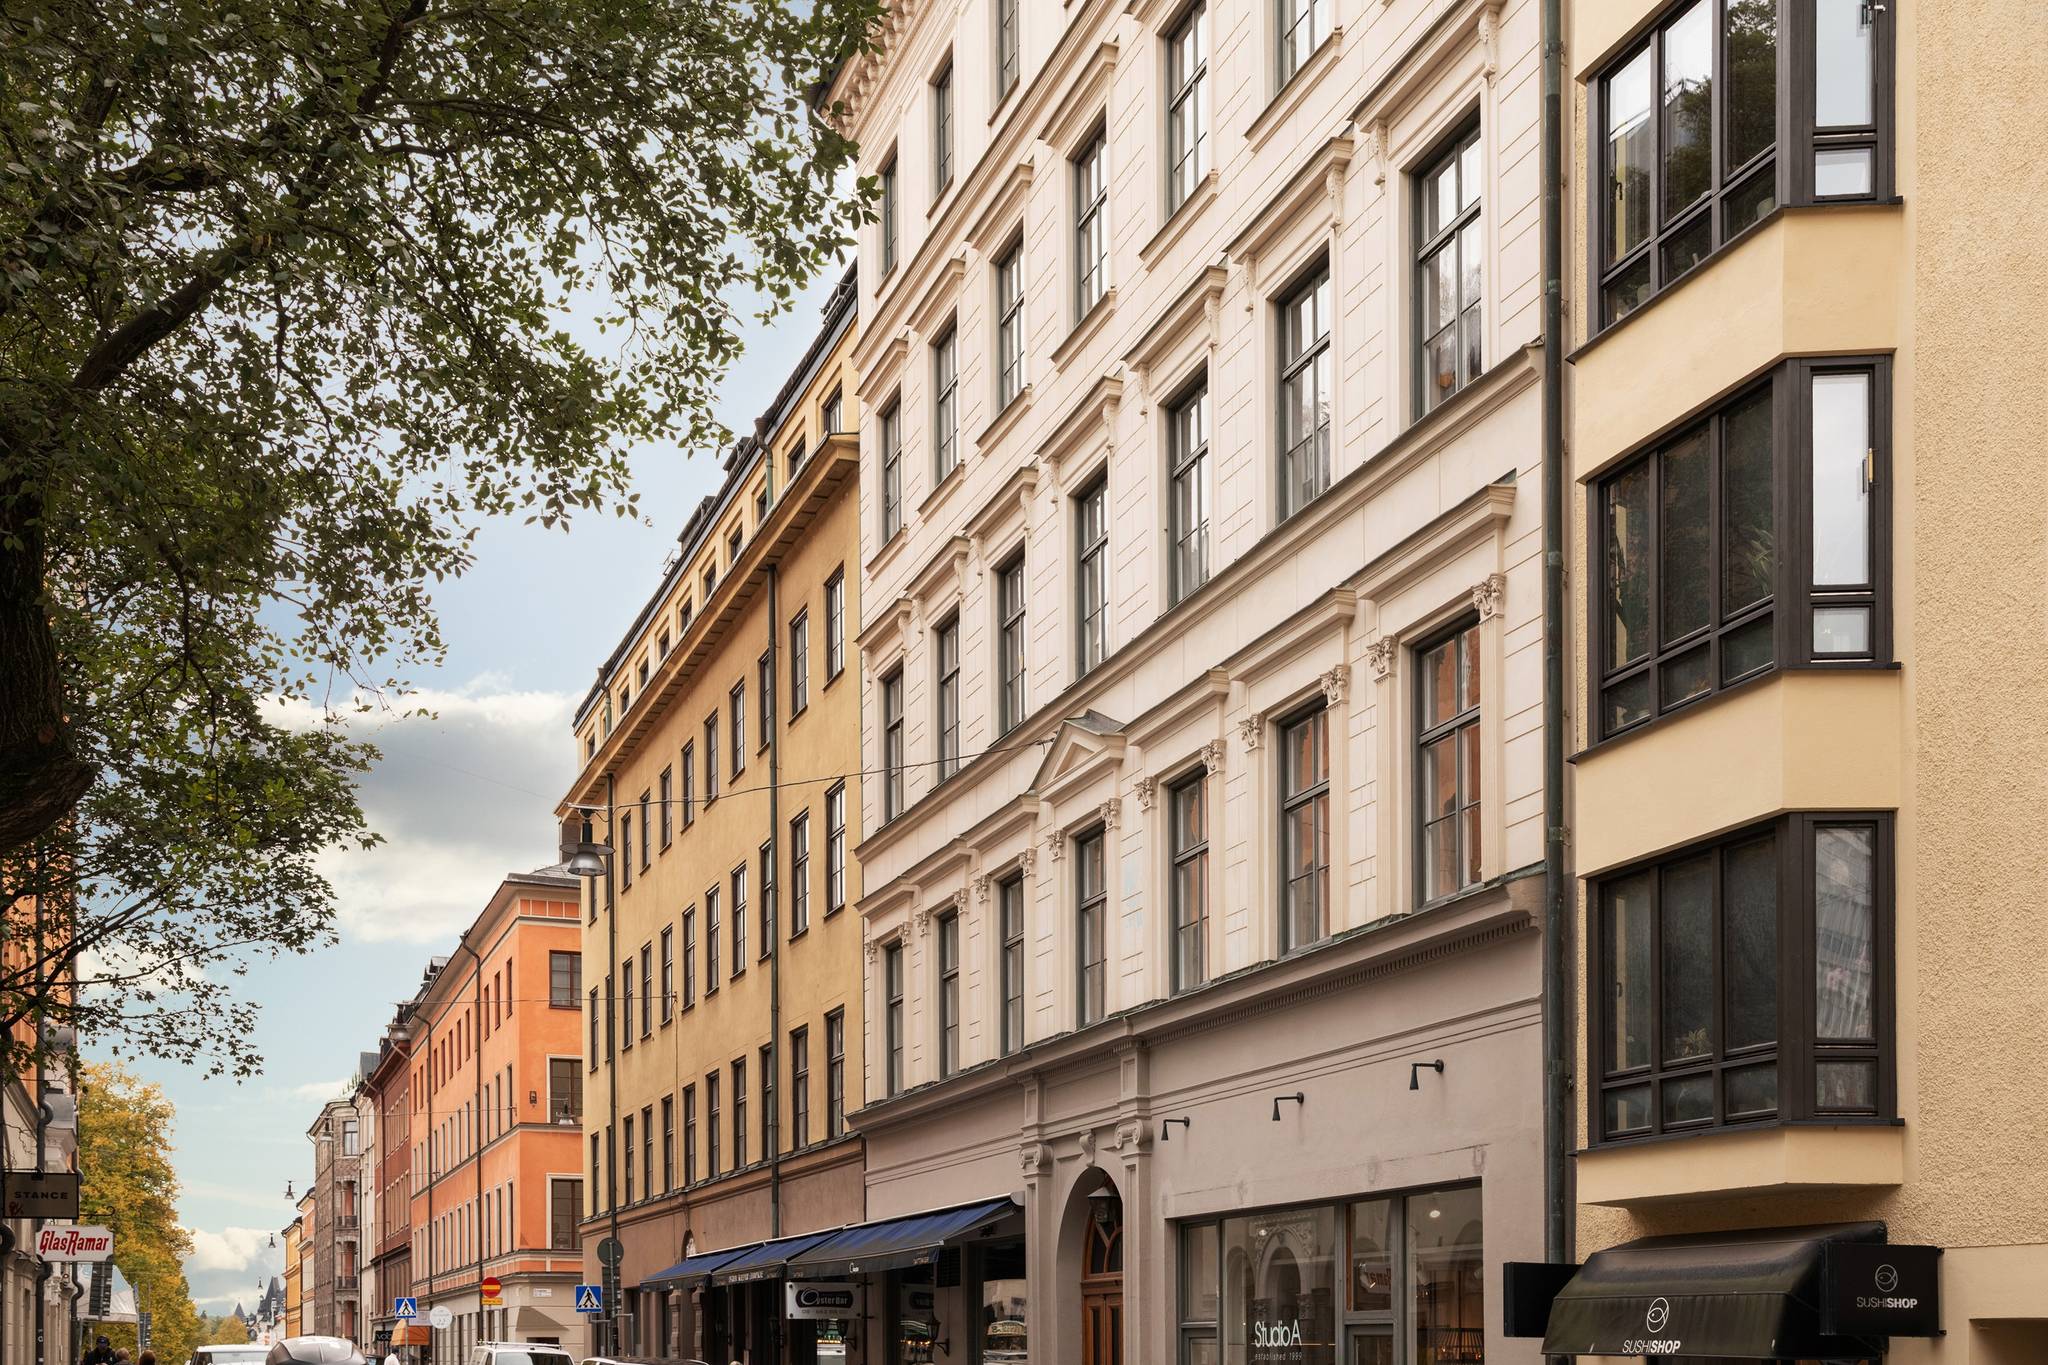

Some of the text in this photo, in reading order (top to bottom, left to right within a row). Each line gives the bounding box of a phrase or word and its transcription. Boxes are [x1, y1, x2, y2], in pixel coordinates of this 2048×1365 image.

[14, 1191, 69, 1200] STANCE
[1856, 1296, 1918, 1309] SUSHISHOP
[1622, 1339, 1681, 1353] SUSHISHOP
[1255, 1351, 1303, 1361] established 1999
